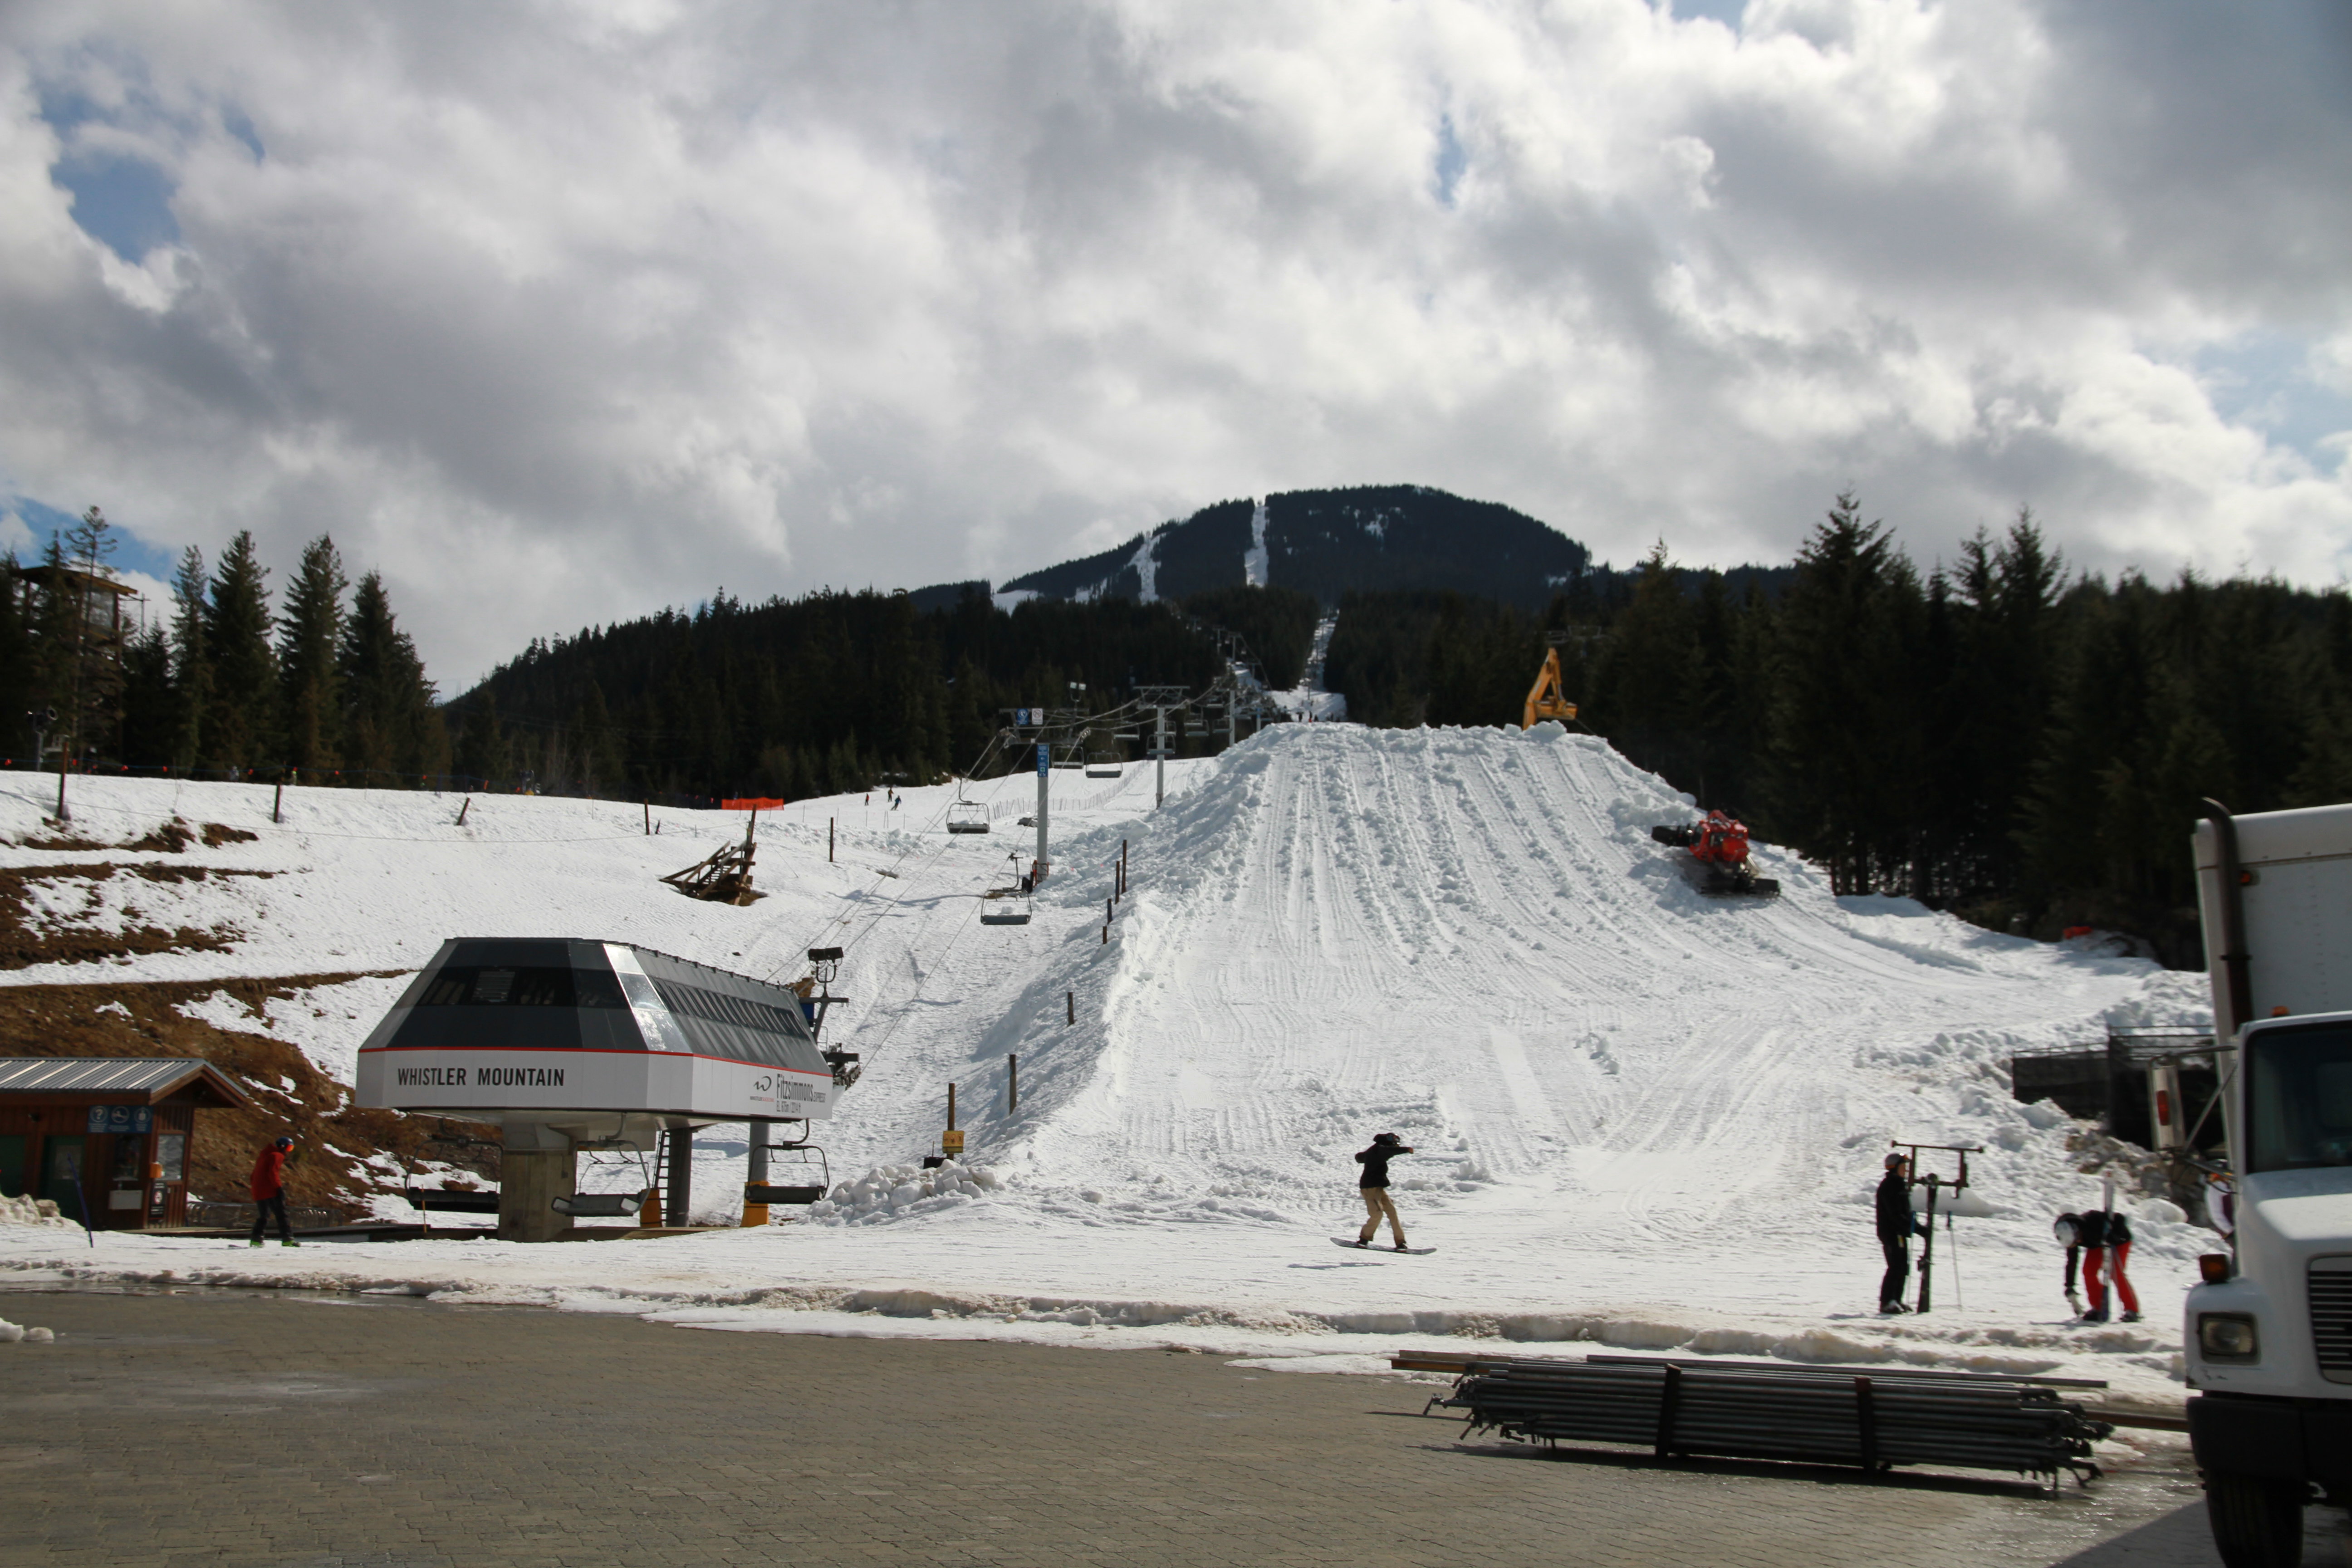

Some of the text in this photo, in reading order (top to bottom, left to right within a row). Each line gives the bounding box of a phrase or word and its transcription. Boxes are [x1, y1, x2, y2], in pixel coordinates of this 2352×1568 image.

[398, 1068, 564, 1087] WHISTLER MOUNTAIN
[777, 1073, 813, 1102] Fitzsimmons
